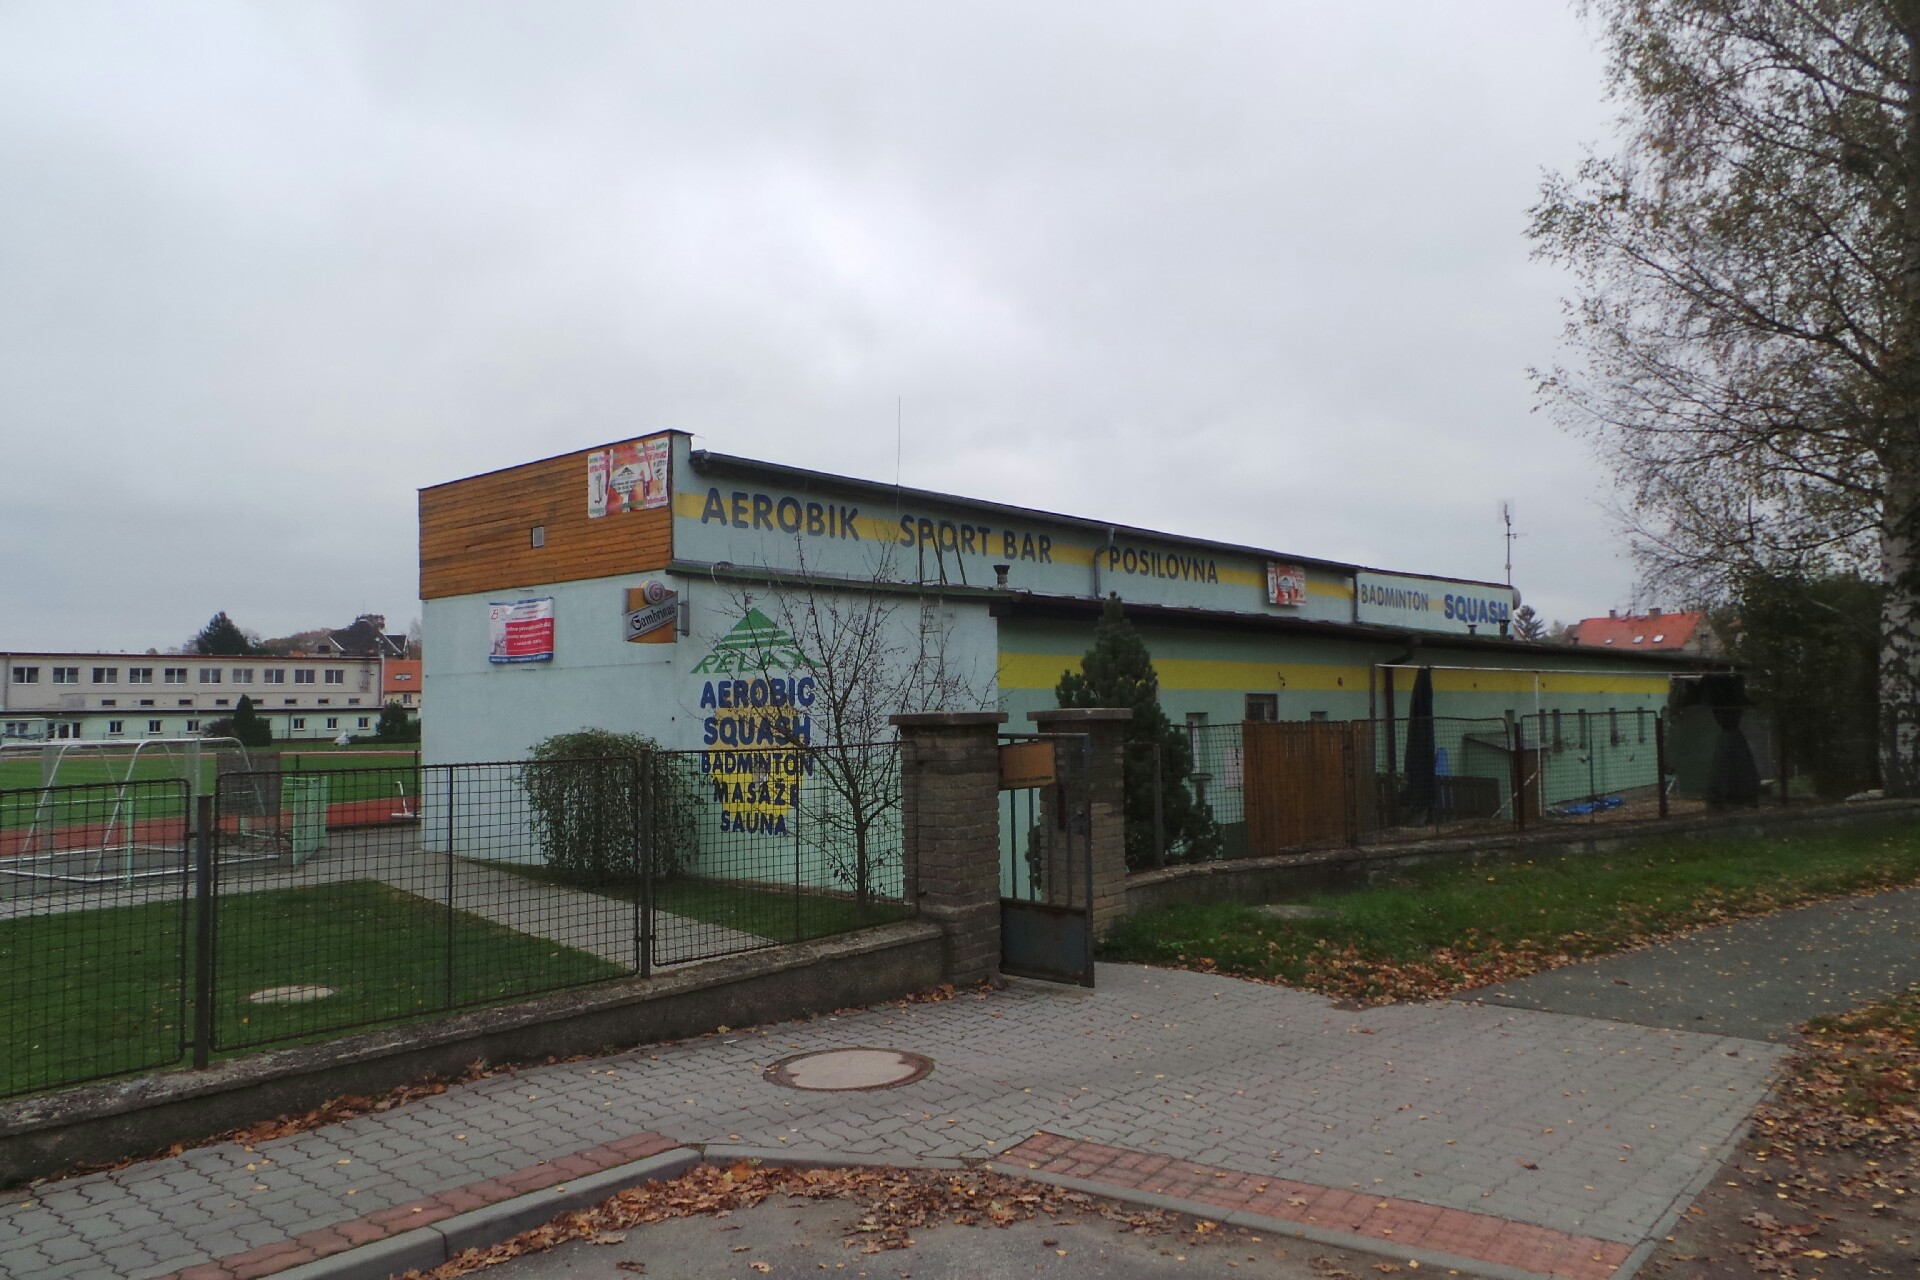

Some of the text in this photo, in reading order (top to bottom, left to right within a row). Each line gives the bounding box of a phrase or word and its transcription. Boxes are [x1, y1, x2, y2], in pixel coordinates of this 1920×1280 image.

[701, 487, 1218, 584] AEROBIK SPORT BAR POSILOVNA
[631, 604, 675, 631] Gambrinus
[1361, 583, 1509, 624] BADMINTON SQUASH
[690, 648, 827, 674] RELAX
[700, 676, 816, 709] AEROBIC
[703, 714, 811, 748] SQUASH
[701, 751, 814, 777] BADMINTON
[720, 810, 788, 837] SAUNA
